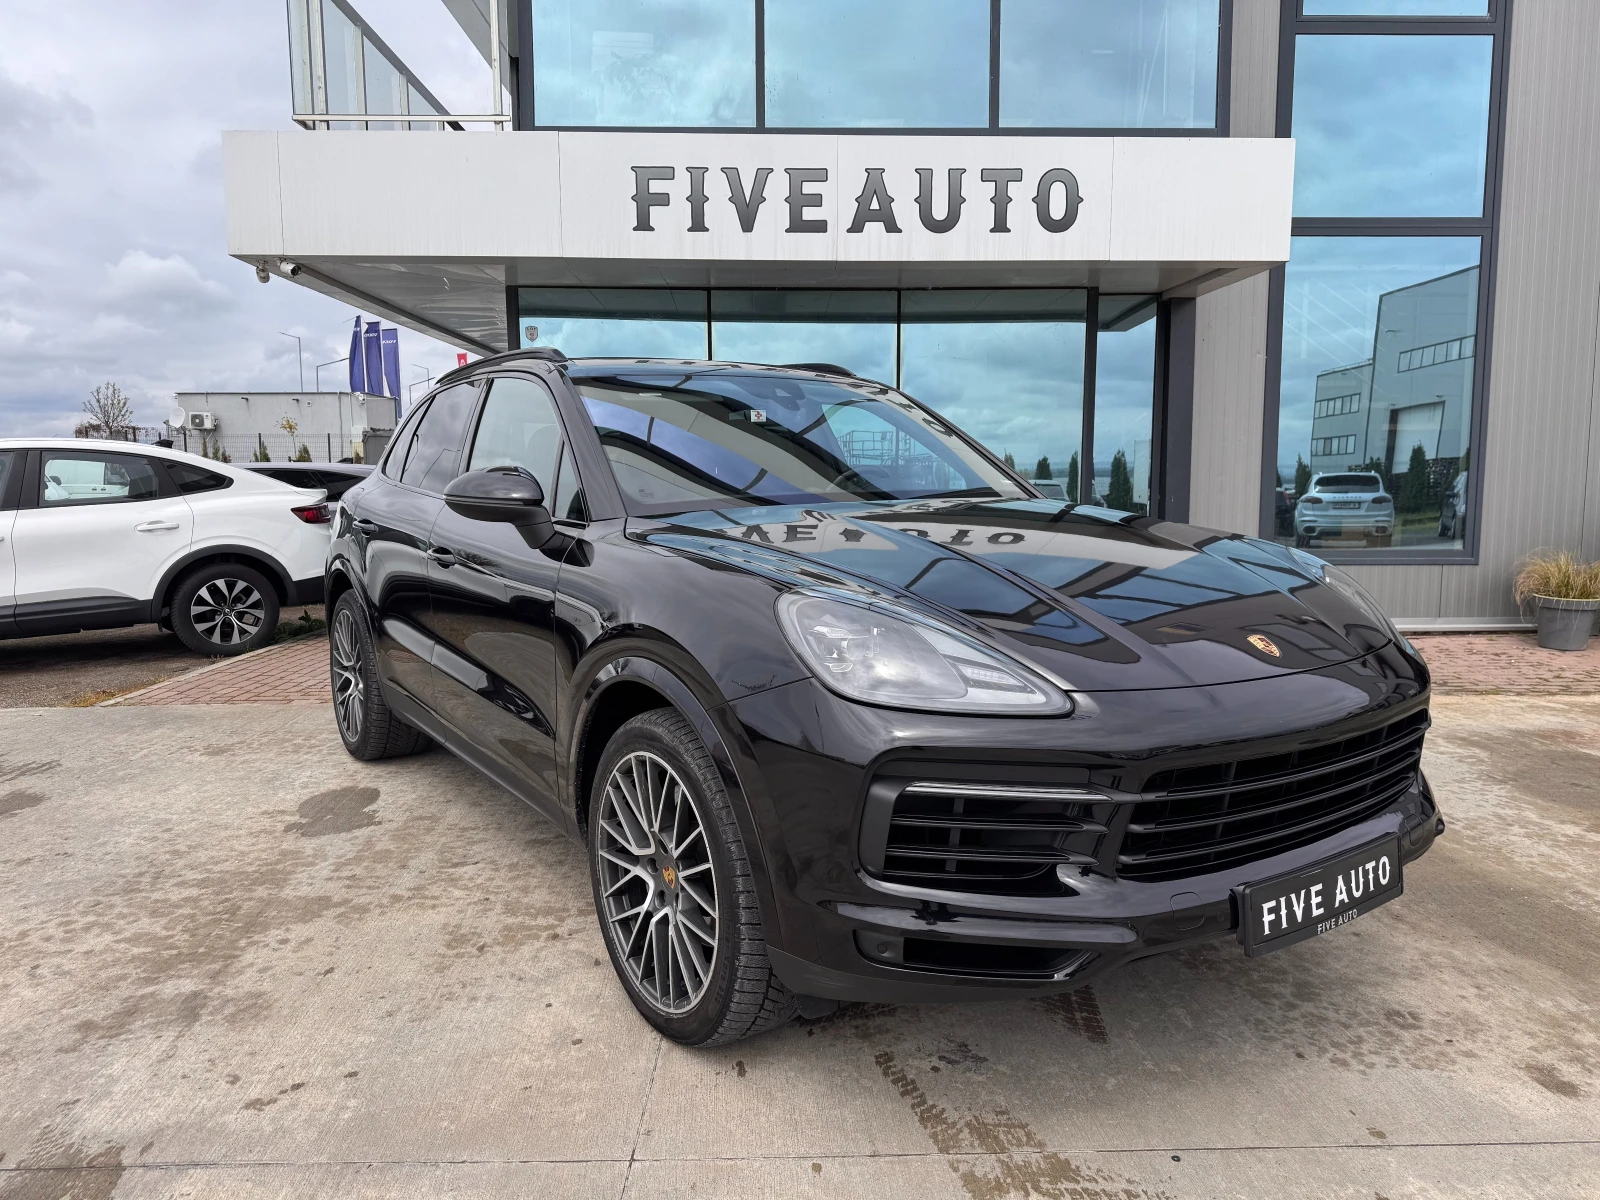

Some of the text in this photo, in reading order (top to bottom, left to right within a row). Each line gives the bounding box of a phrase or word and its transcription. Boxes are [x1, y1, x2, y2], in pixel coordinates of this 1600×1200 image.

[631, 166, 1084, 234] FIVE AUTO
[1262, 855, 1390, 936] FIVE AUTO
[1317, 908, 1358, 935] FIVE AUTO
